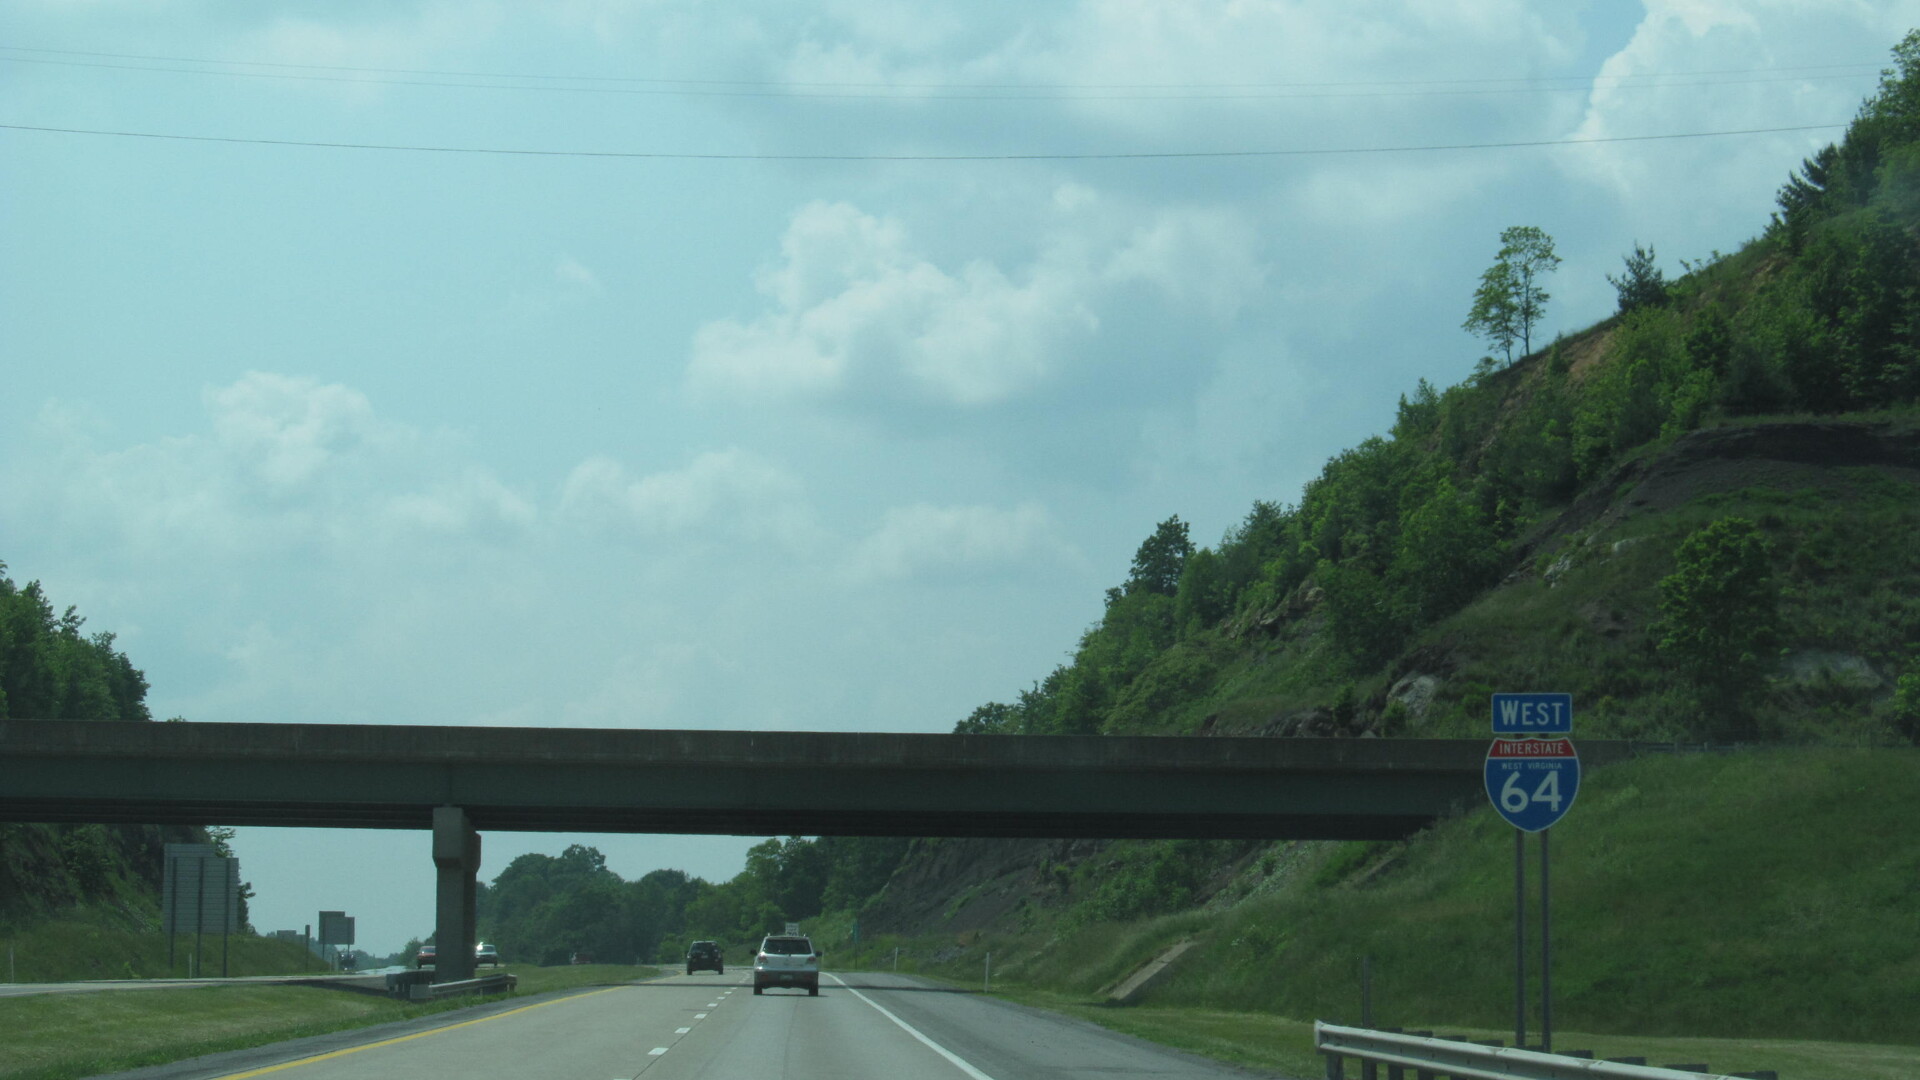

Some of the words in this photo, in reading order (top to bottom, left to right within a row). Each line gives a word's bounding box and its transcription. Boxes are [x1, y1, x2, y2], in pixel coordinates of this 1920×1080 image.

[1500, 700, 1564, 726] WEST
[1499, 742, 1565, 754] INTERSTATE
[1501, 762, 1523, 770] WEST
[1527, 762, 1563, 770] VIRGINIA
[1500, 770, 1563, 813] 64
